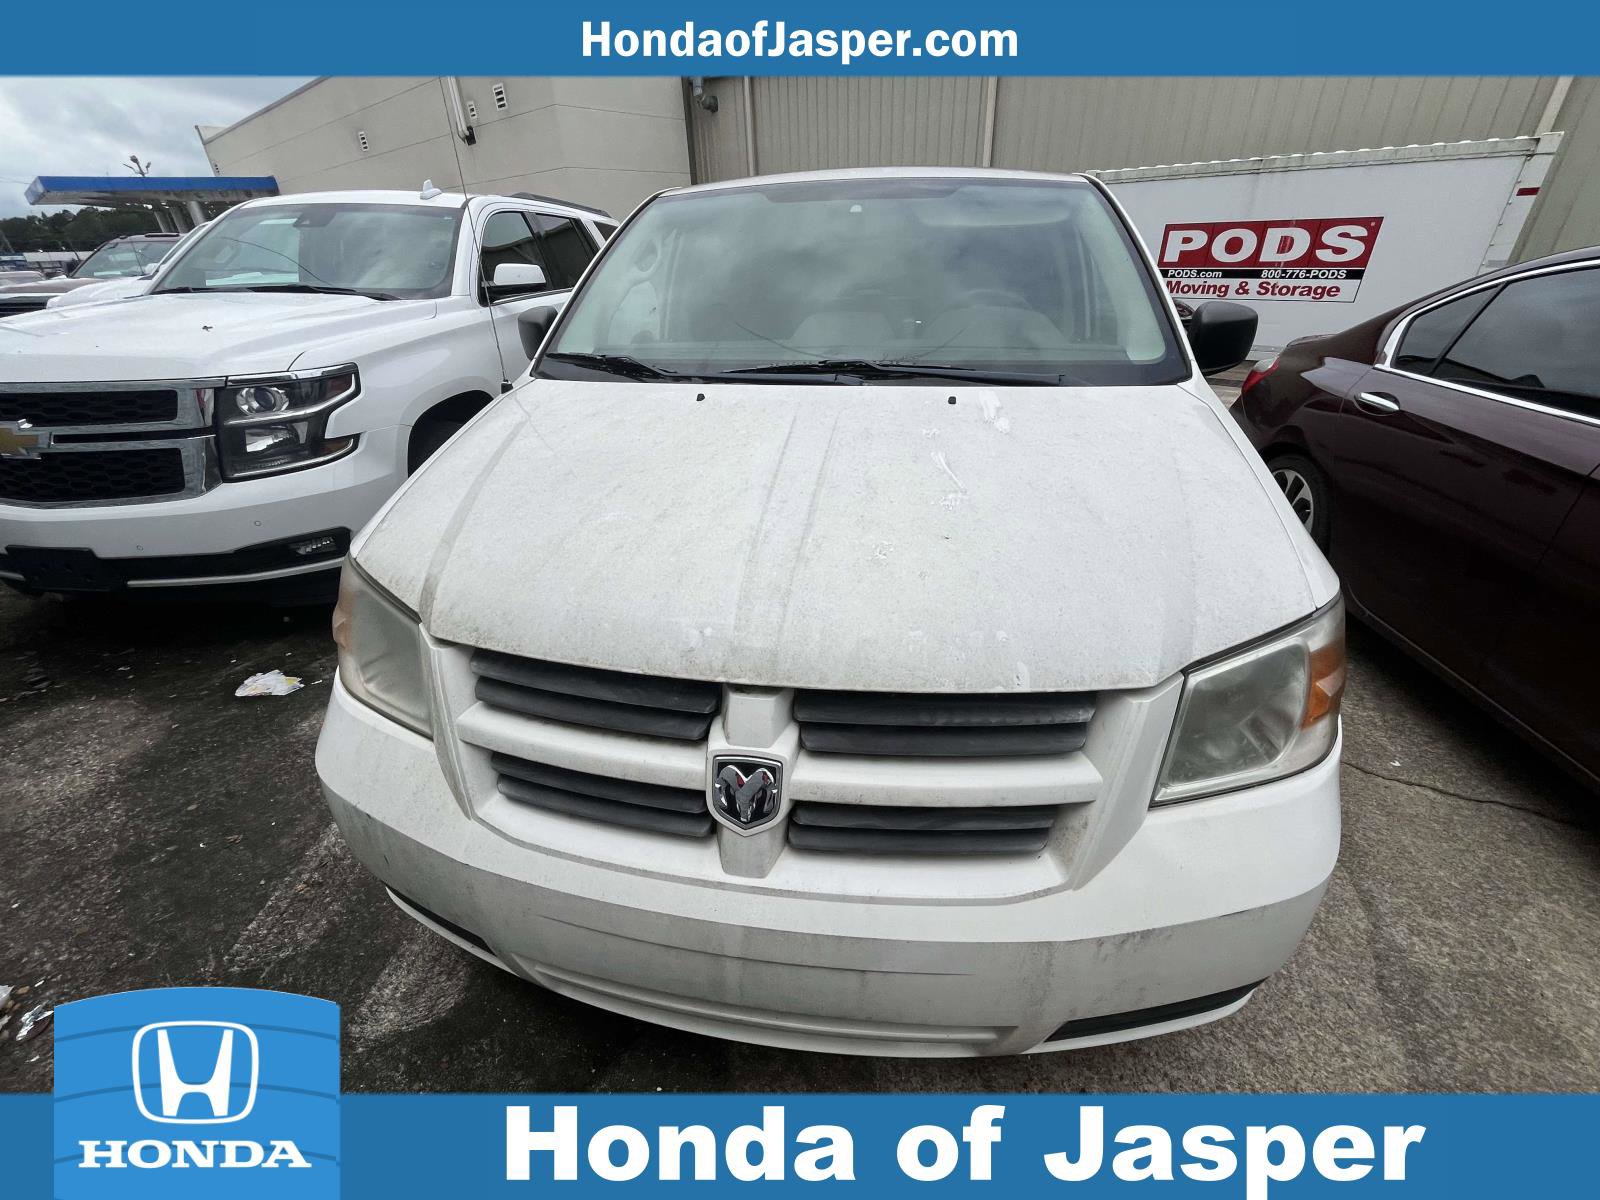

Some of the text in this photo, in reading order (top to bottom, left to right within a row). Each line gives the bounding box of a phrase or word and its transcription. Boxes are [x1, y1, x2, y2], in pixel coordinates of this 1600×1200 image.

[1163, 225, 1369, 263] PODS
[1167, 269, 1223, 279] PODS.com
[1260, 269, 1348, 280] 800-776-PODS
[1165, 280, 1341, 301] Moving & Storage
